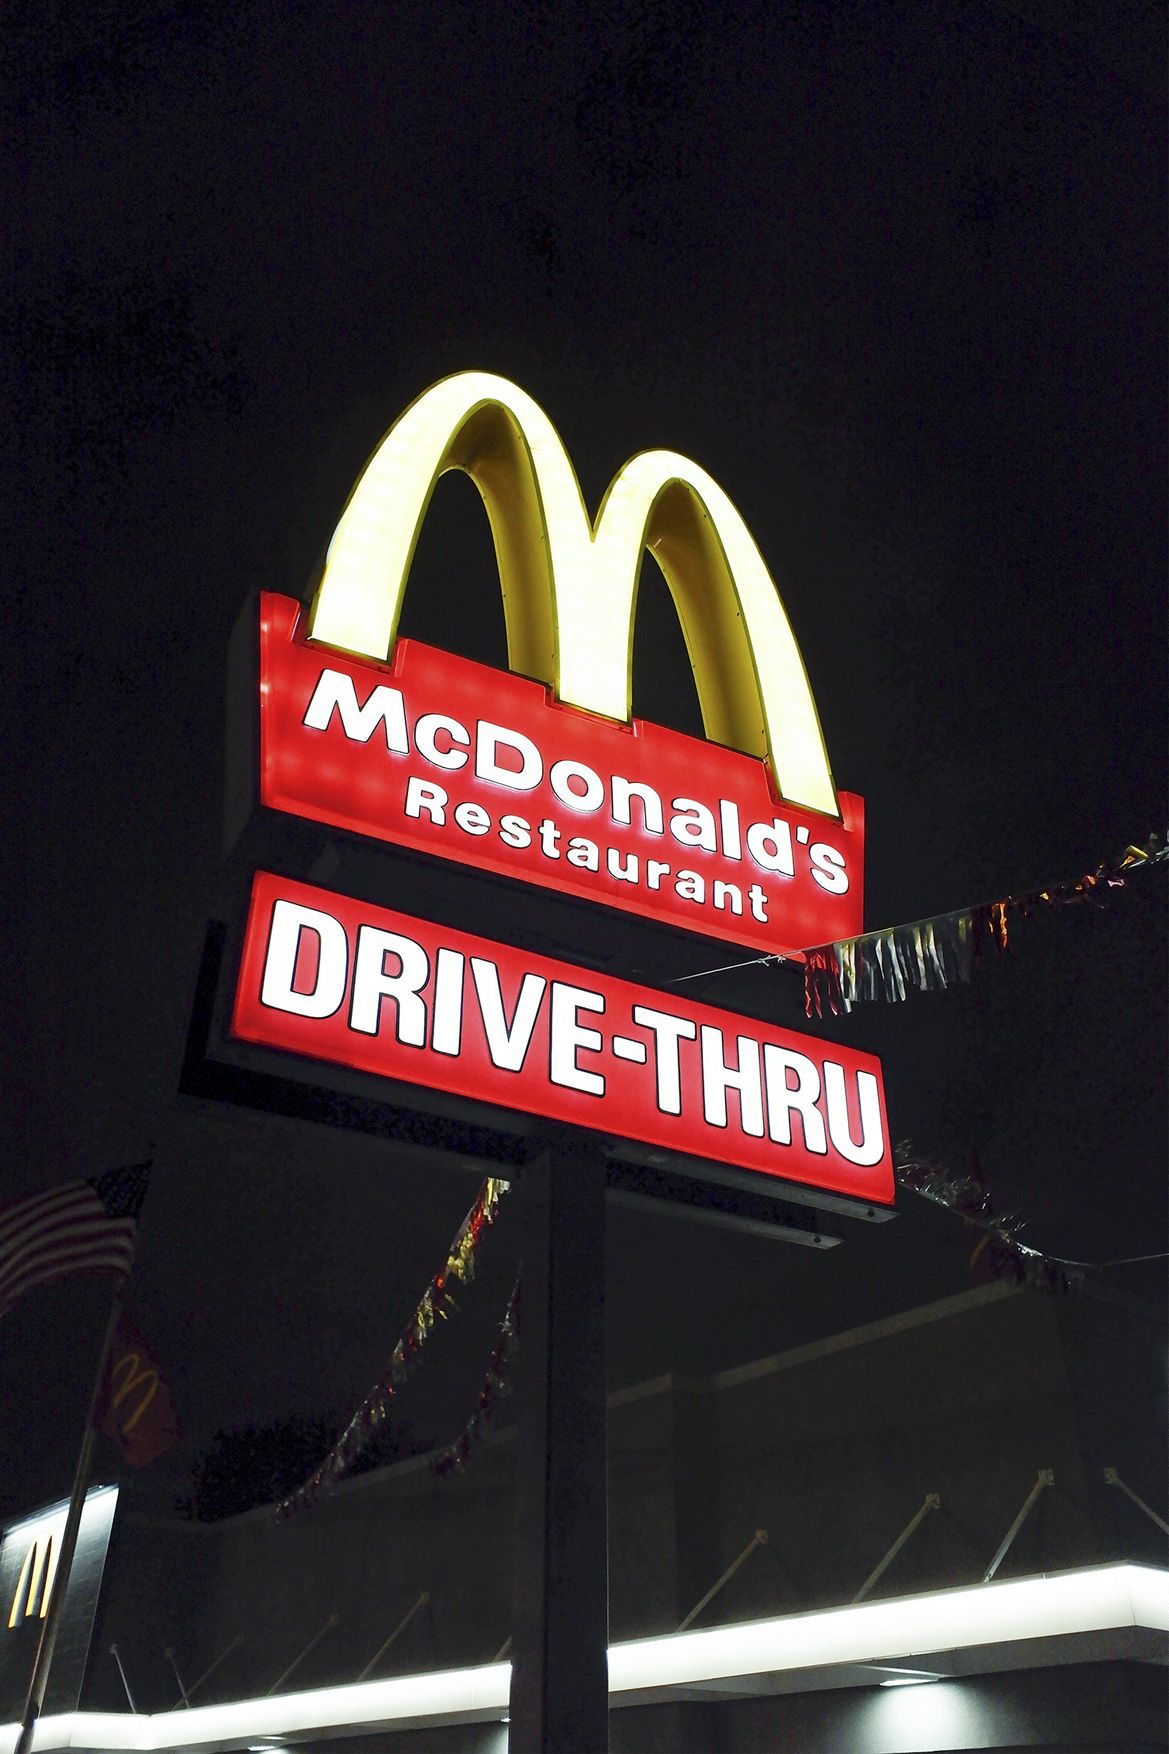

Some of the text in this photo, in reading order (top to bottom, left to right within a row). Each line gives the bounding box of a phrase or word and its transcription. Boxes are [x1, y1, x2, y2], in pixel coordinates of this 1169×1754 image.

[302, 667, 851, 896] McDonald's
[404, 775, 769, 924] Restaurant
[259, 898, 886, 1167] DRIVE-THRU
